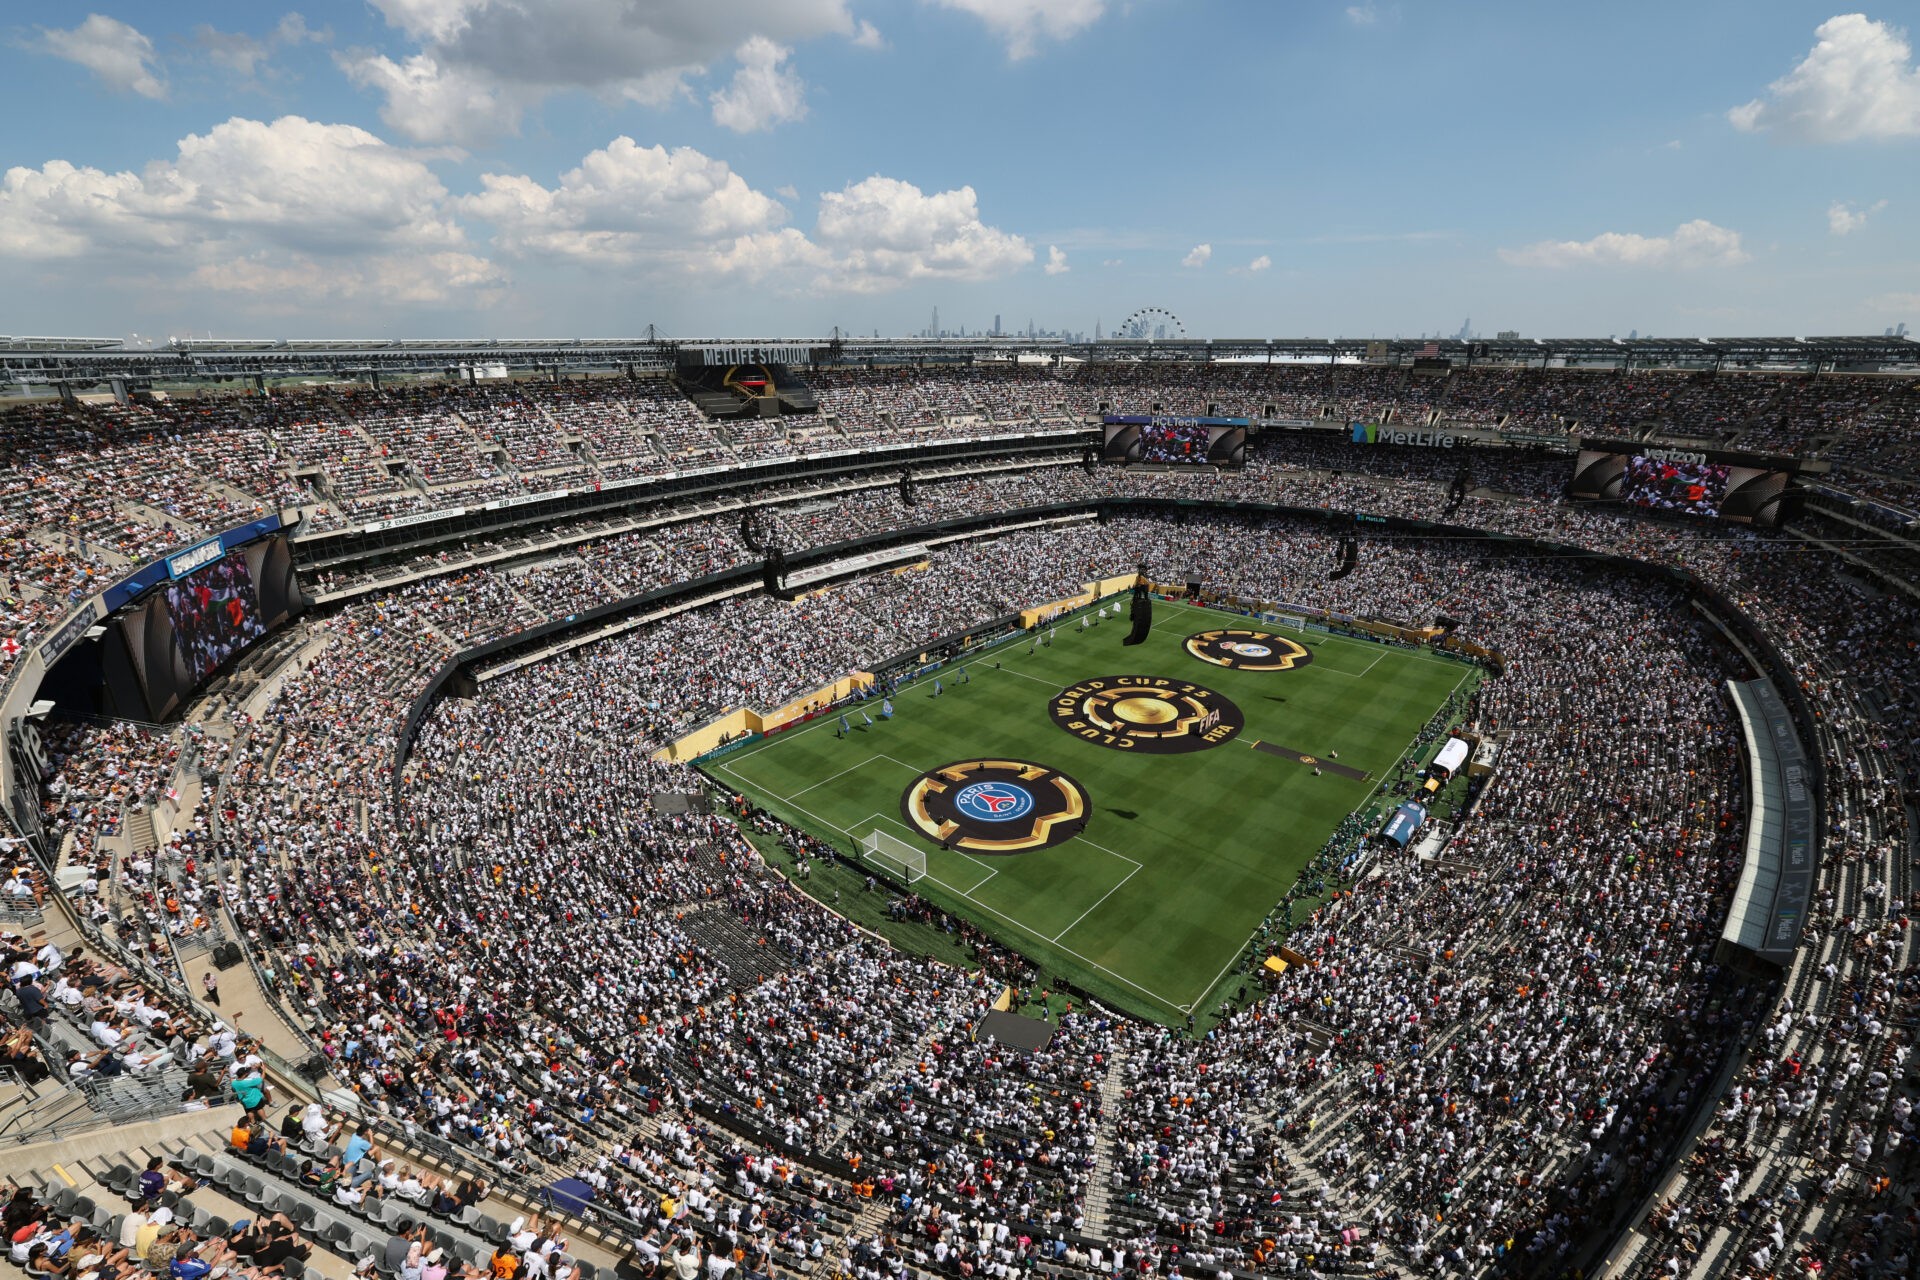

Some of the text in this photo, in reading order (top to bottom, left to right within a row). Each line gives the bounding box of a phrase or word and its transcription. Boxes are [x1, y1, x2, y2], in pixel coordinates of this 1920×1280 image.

[703, 347, 810, 366] METLIFE STADIUM
[1151, 417, 1198, 428] HCLTech
[1377, 428, 1455, 448] MetLife
[1644, 447, 1707, 465] verizon
[511, 495, 533, 505] WAYNE
[378, 509, 454, 530] 32 EMERSON BOOZER
[1365, 515, 1386, 523] MetLife
[1056, 677, 1212, 717] WORLD CUP 25
[1199, 708, 1220, 734] FIFA
[1067, 721, 1135, 748] CLUB
[1201, 723, 1235, 743] FIFA
[708, 741, 744, 760] Hisense
[960, 783, 995, 804] PARIS
[138, 1184, 145, 1196] 5
